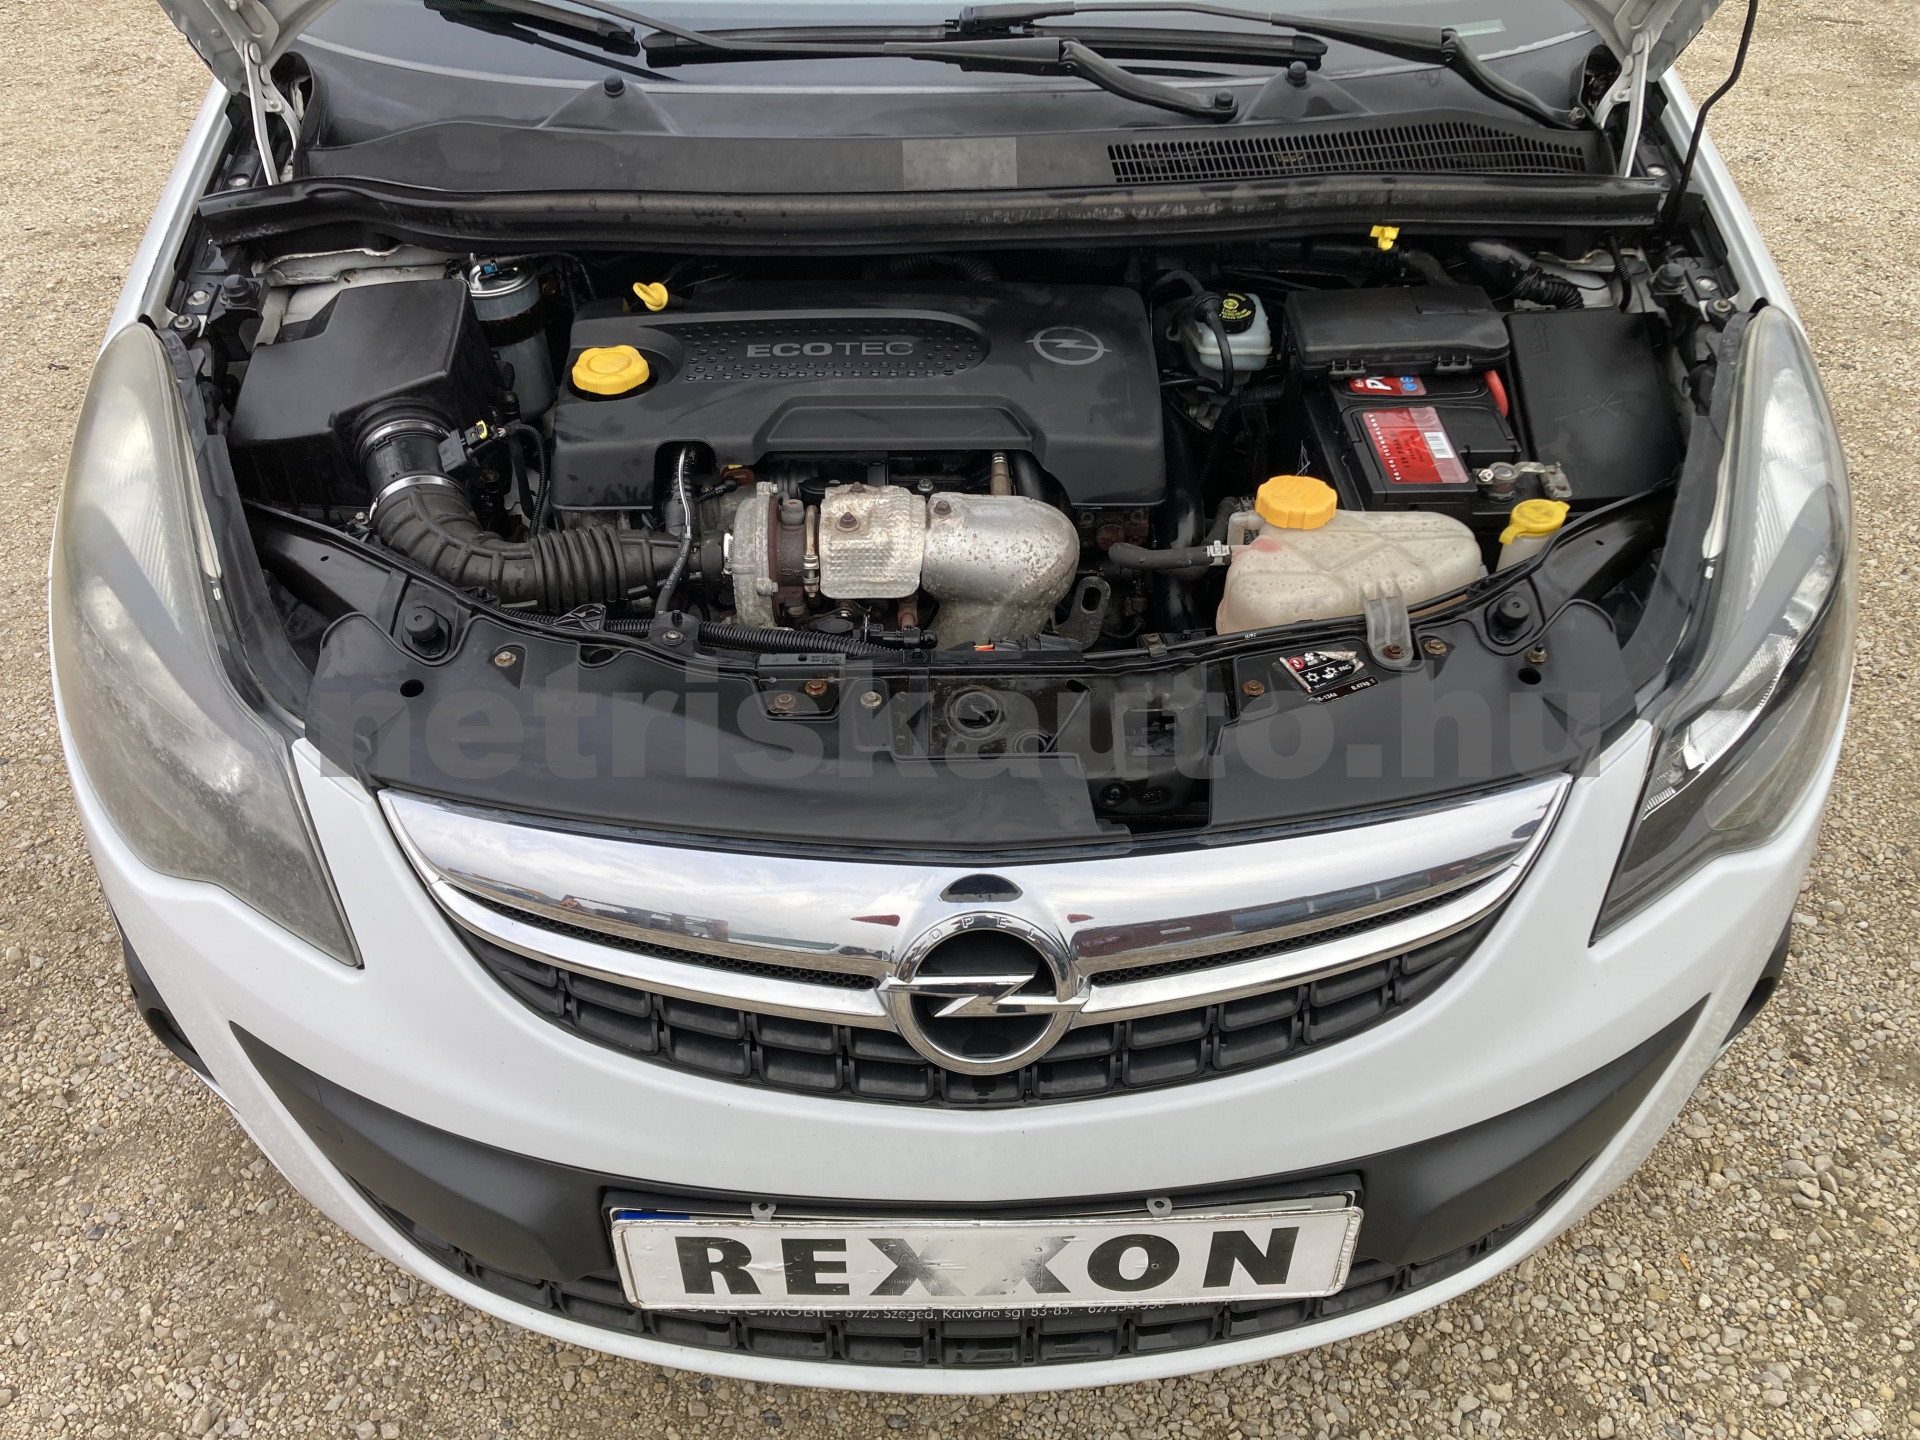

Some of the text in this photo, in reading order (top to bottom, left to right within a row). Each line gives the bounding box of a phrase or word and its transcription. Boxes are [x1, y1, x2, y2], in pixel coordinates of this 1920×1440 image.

[746, 341, 914, 358] ECOTEC
[928, 915, 1036, 942] OPEL
[675, 1226, 1300, 1296] REXXON
